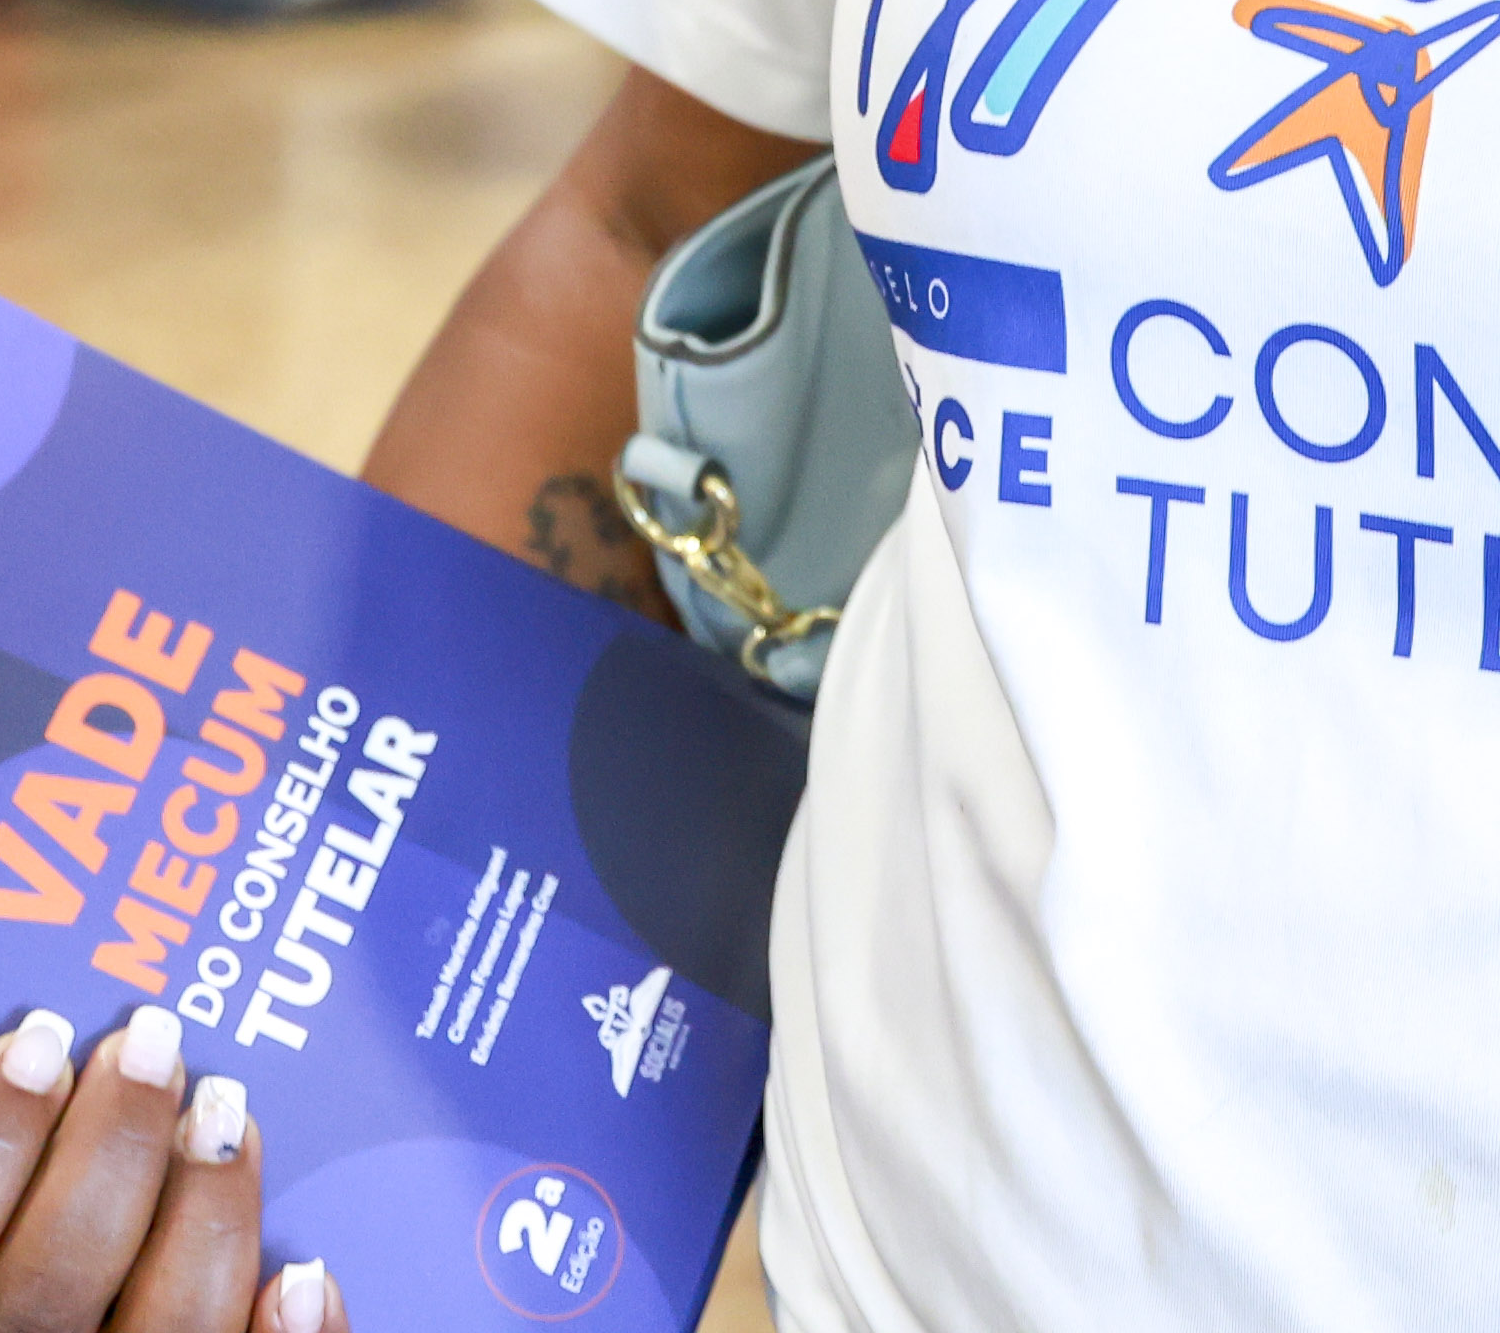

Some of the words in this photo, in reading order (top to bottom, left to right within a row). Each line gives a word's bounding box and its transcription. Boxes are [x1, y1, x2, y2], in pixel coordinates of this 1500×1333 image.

[91, 648, 306, 996] MECUM
[177, 946, 242, 1028] DO
[219, 685, 360, 942] CONSELHO
[235, 715, 438, 1051] TUTELAR
[560, 1217, 605, 1293] Edição
